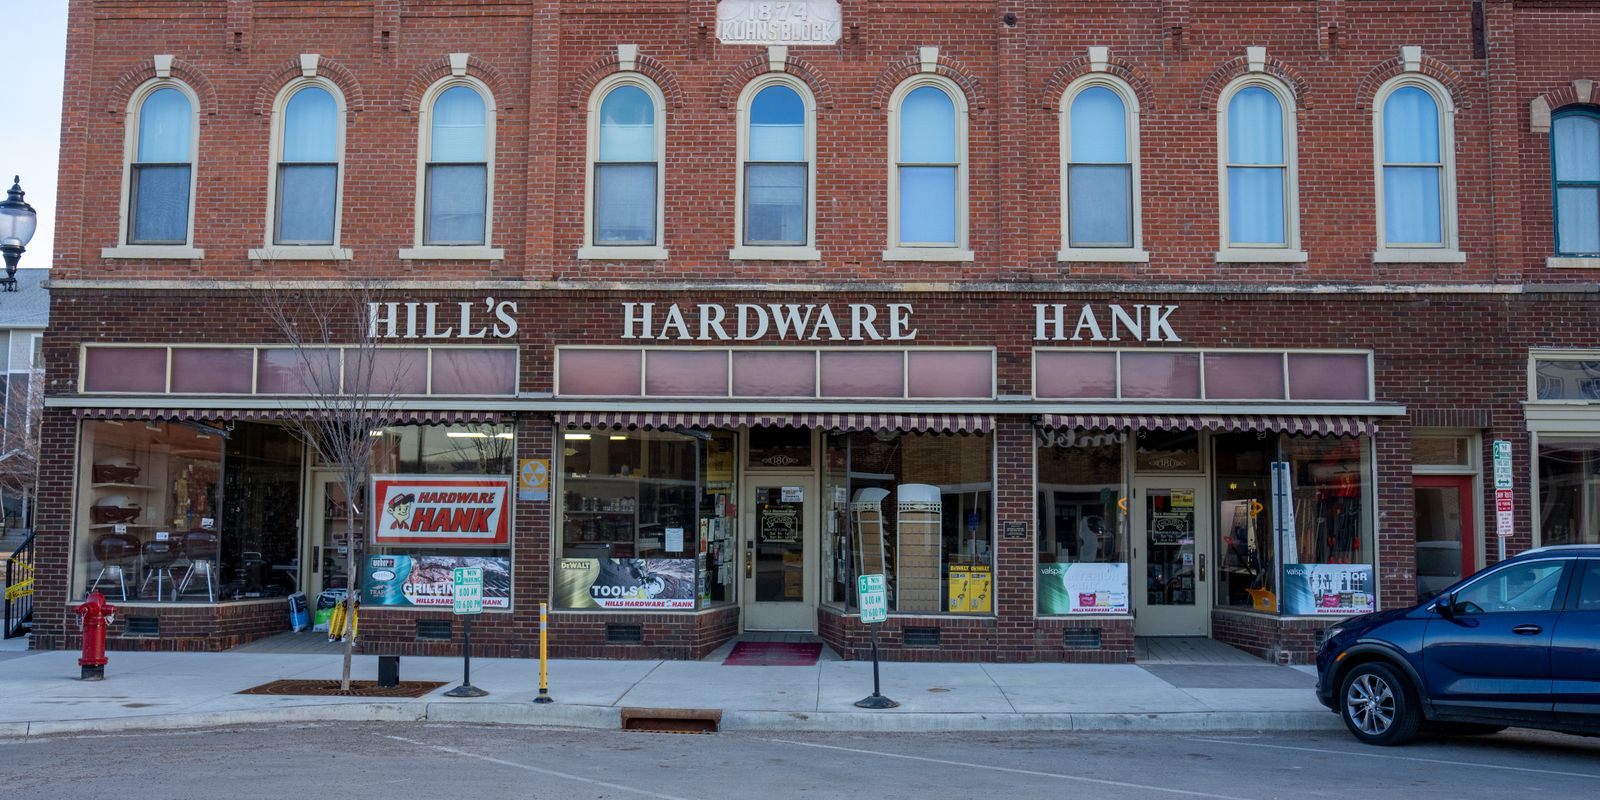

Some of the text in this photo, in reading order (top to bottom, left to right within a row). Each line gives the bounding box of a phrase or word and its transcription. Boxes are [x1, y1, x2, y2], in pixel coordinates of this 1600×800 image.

[748, 0, 808, 21] 1874
[721, 21, 838, 41] KUHNS BLOCK
[366, 296, 1182, 341] HILL'S HARDWARE HANK
[772, 455, 789, 465] 180
[417, 492, 496, 503] HARDWARE
[409, 507, 496, 532] HANK
[591, 585, 639, 597] TOOLS
